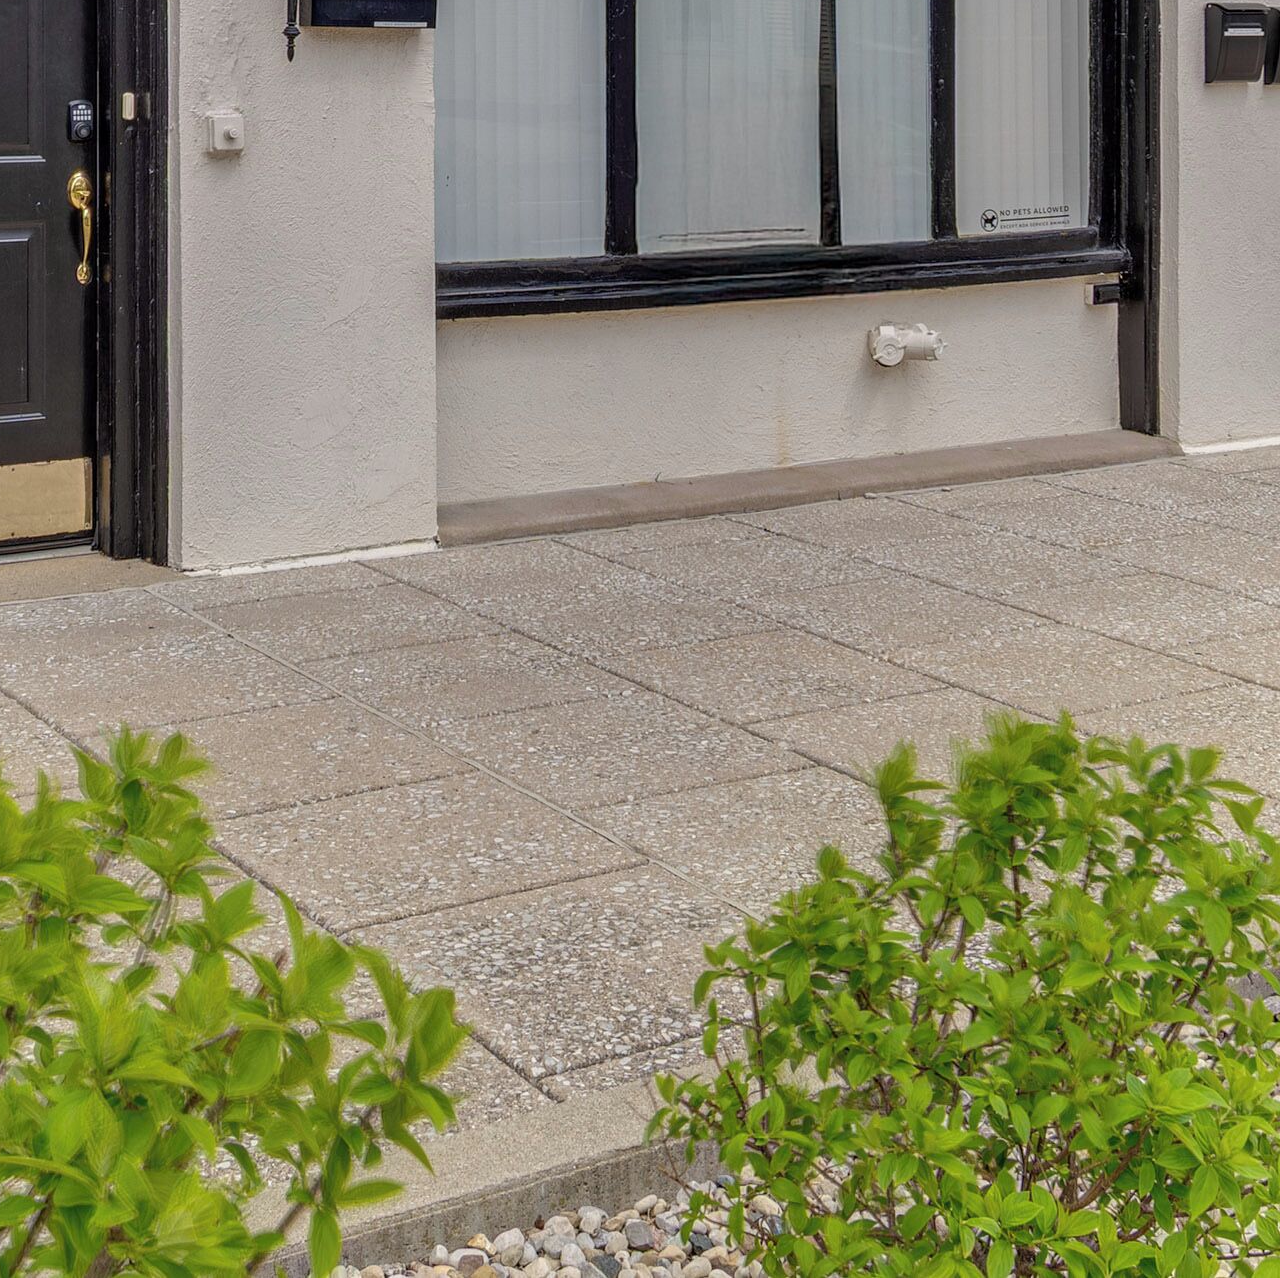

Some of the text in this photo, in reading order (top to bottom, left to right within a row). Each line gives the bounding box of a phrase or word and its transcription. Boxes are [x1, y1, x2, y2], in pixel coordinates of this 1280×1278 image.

[999, 205, 1070, 217] NO PETS ALLOWED
